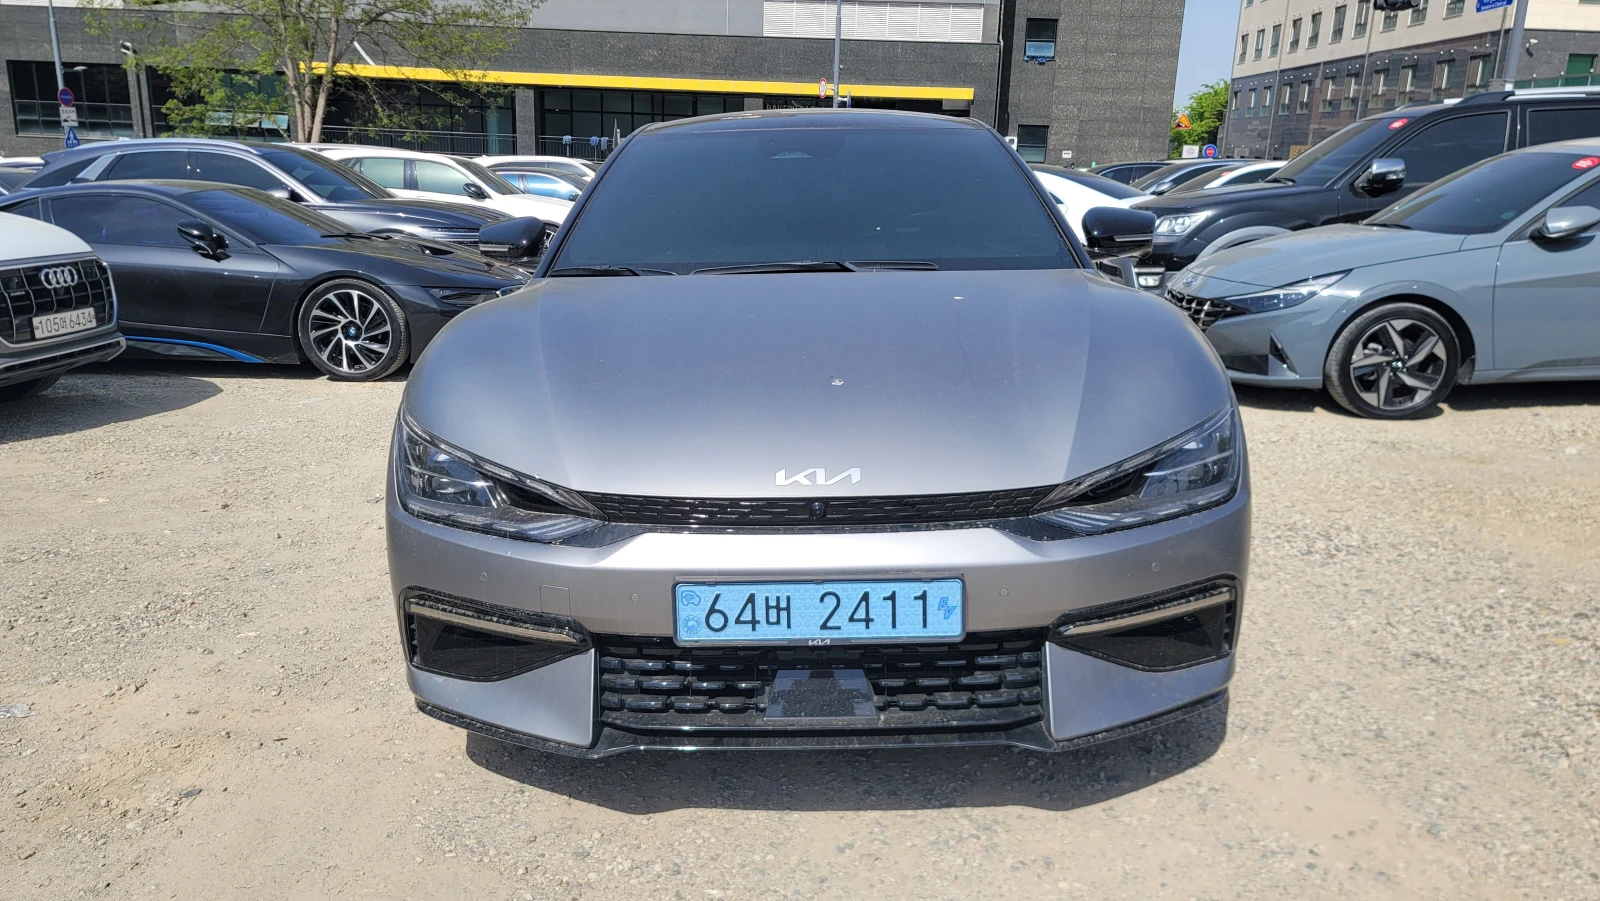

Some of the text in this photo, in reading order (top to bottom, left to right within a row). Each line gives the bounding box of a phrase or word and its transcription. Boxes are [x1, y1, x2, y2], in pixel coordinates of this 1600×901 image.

[69, 311, 92, 328] 6434
[775, 467, 862, 486] KIA
[704, 590, 928, 632] 64버 2411
[937, 596, 957, 620] EV
